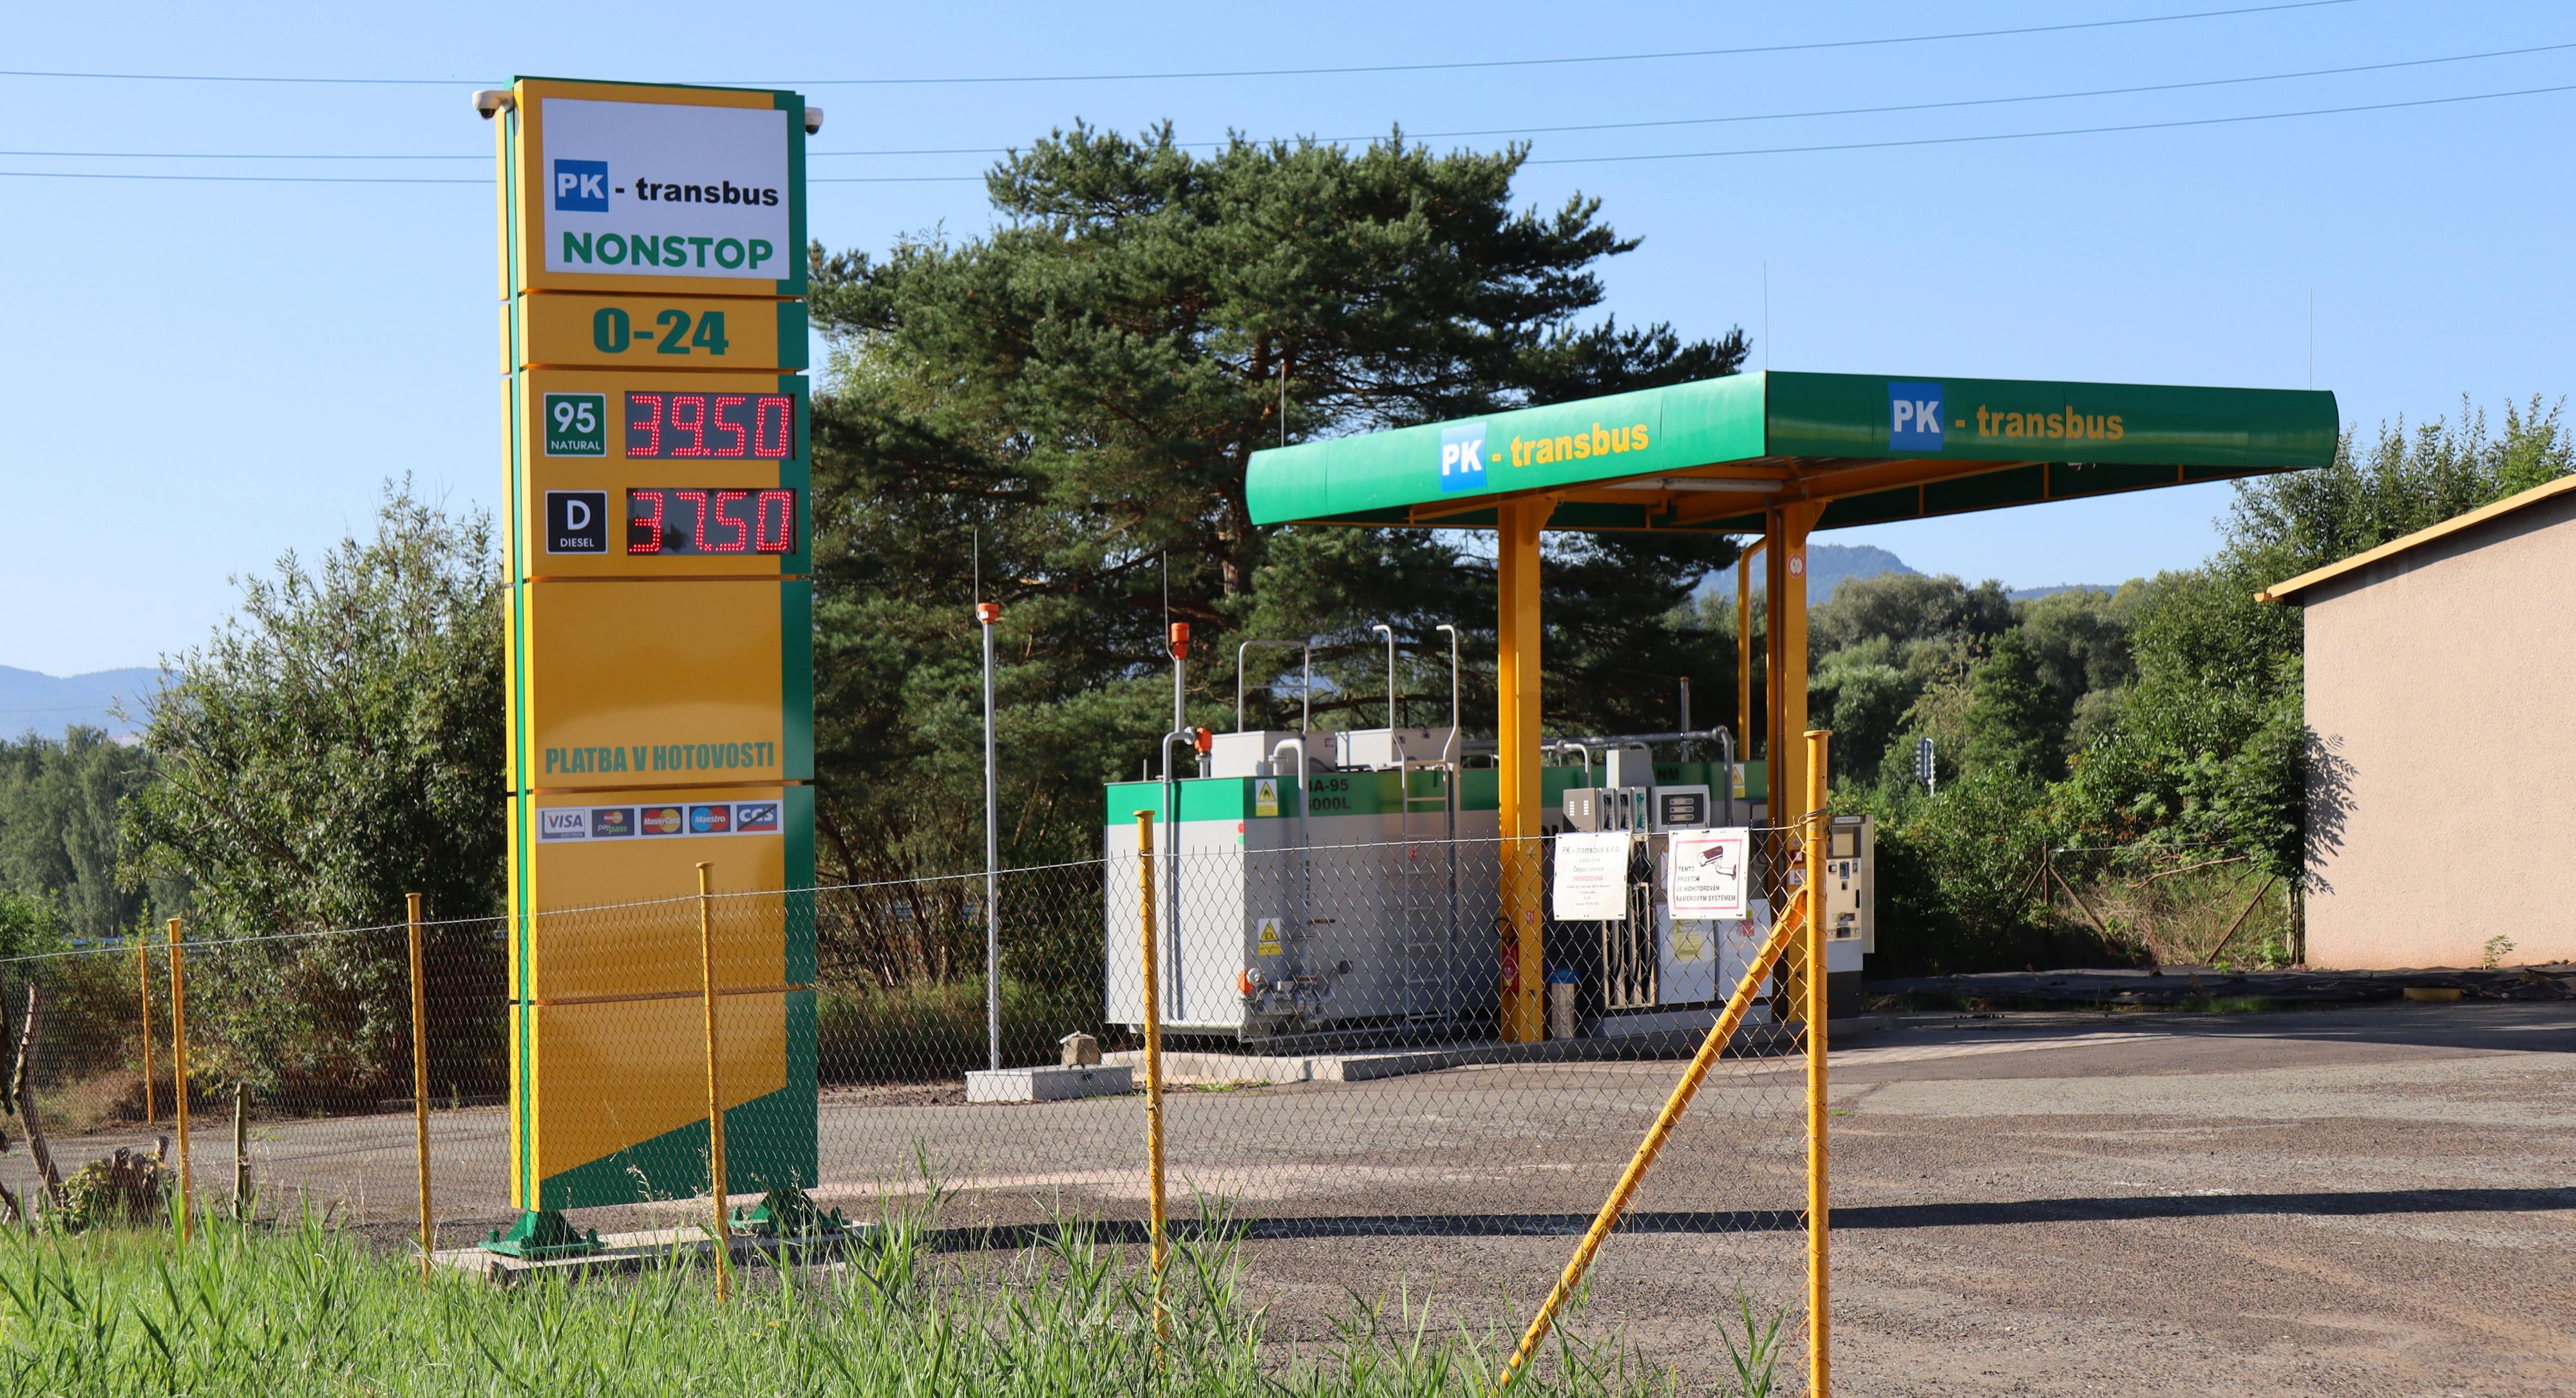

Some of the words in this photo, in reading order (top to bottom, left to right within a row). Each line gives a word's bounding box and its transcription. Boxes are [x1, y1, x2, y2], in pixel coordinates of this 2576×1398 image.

[557, 173, 605, 199] PK
[636, 176, 779, 206] transbus
[563, 231, 773, 269] NONSTOP
[593, 307, 729, 355] 0-24
[554, 402, 596, 433] 95
[1893, 400, 1940, 433] PK
[1976, 404, 2124, 440] transbus
[551, 439, 600, 451] NATURAL
[1441, 439, 1483, 477] PK
[1510, 422, 1649, 467] transbus
[567, 500, 591, 530] D
[560, 538, 594, 547] DIESEL
[545, 746, 628, 774] PLATBA
[632, 746, 647, 772] V
[652, 742, 774, 771] HOTOVOSTI
[547, 815, 583, 829] VISA
[643, 817, 681, 826] MasterCard
[695, 815, 726, 824] Maestro
[1577, 845, 1604, 855] transbus
